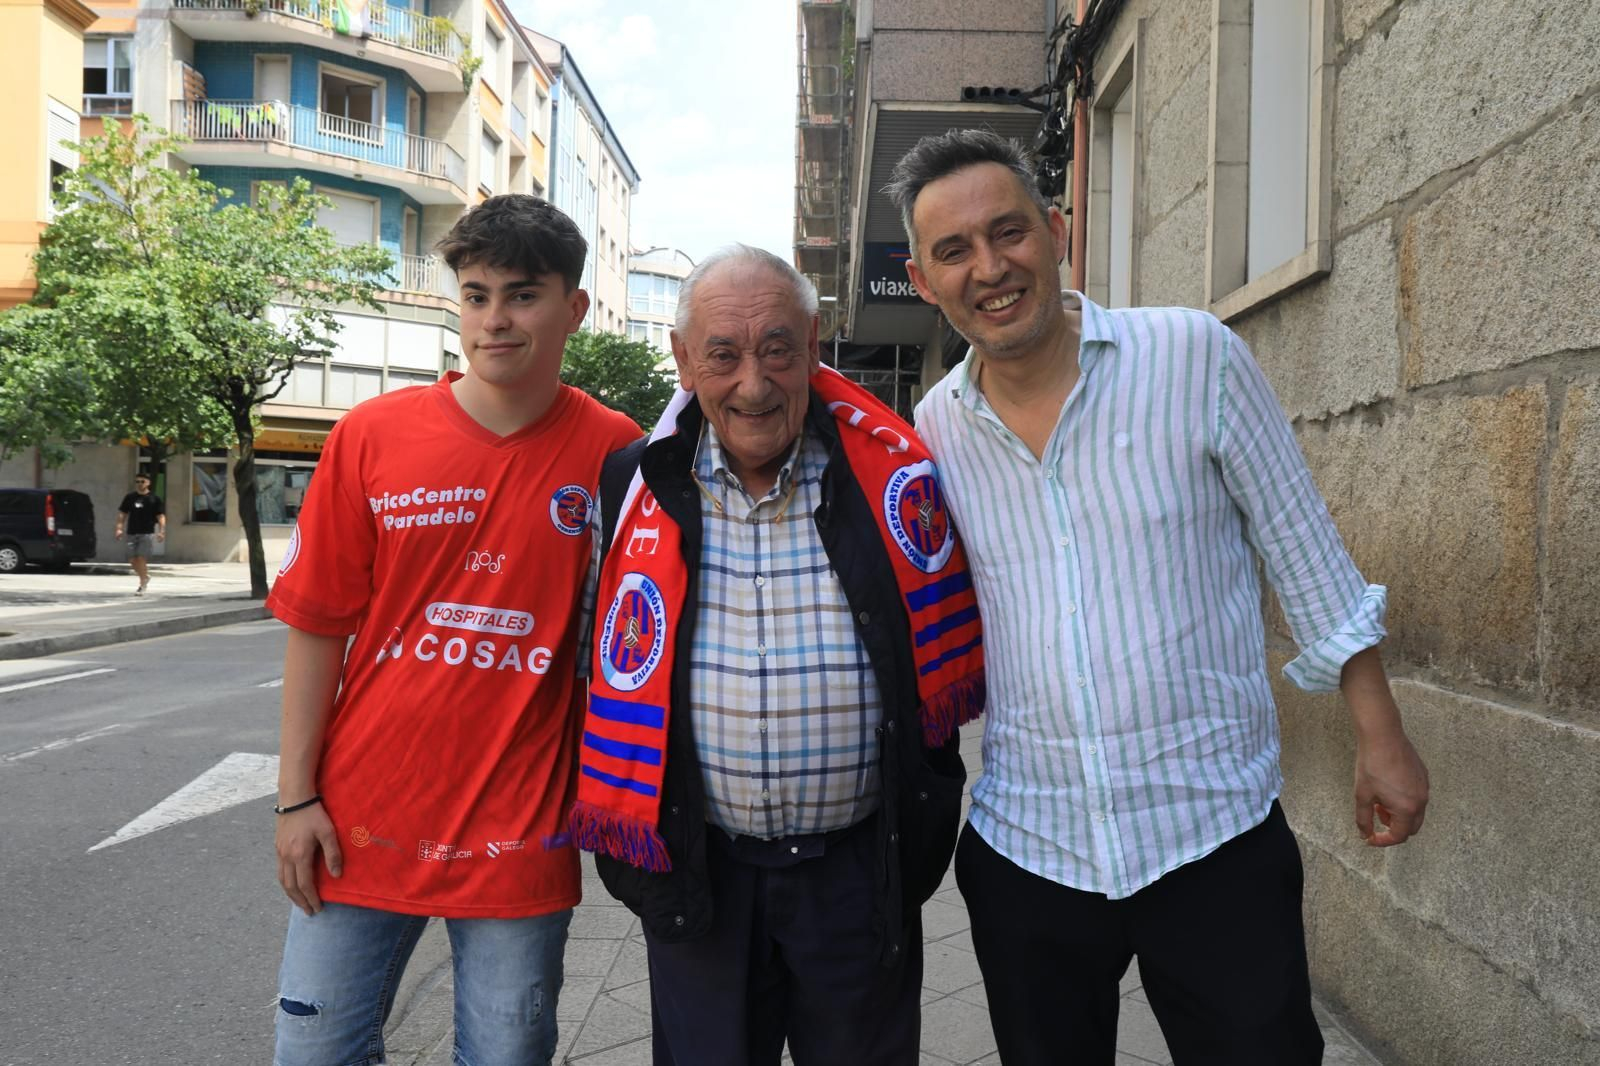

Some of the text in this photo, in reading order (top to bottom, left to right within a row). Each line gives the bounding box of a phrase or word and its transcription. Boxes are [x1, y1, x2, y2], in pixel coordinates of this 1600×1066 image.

[383, 506, 476, 531] Paradelo
[889, 470, 909, 540] DEPORTIVA
[431, 606, 528, 631] HOSPITALES
[631, 579, 662, 686] UNIÓN DEPORTIVA
